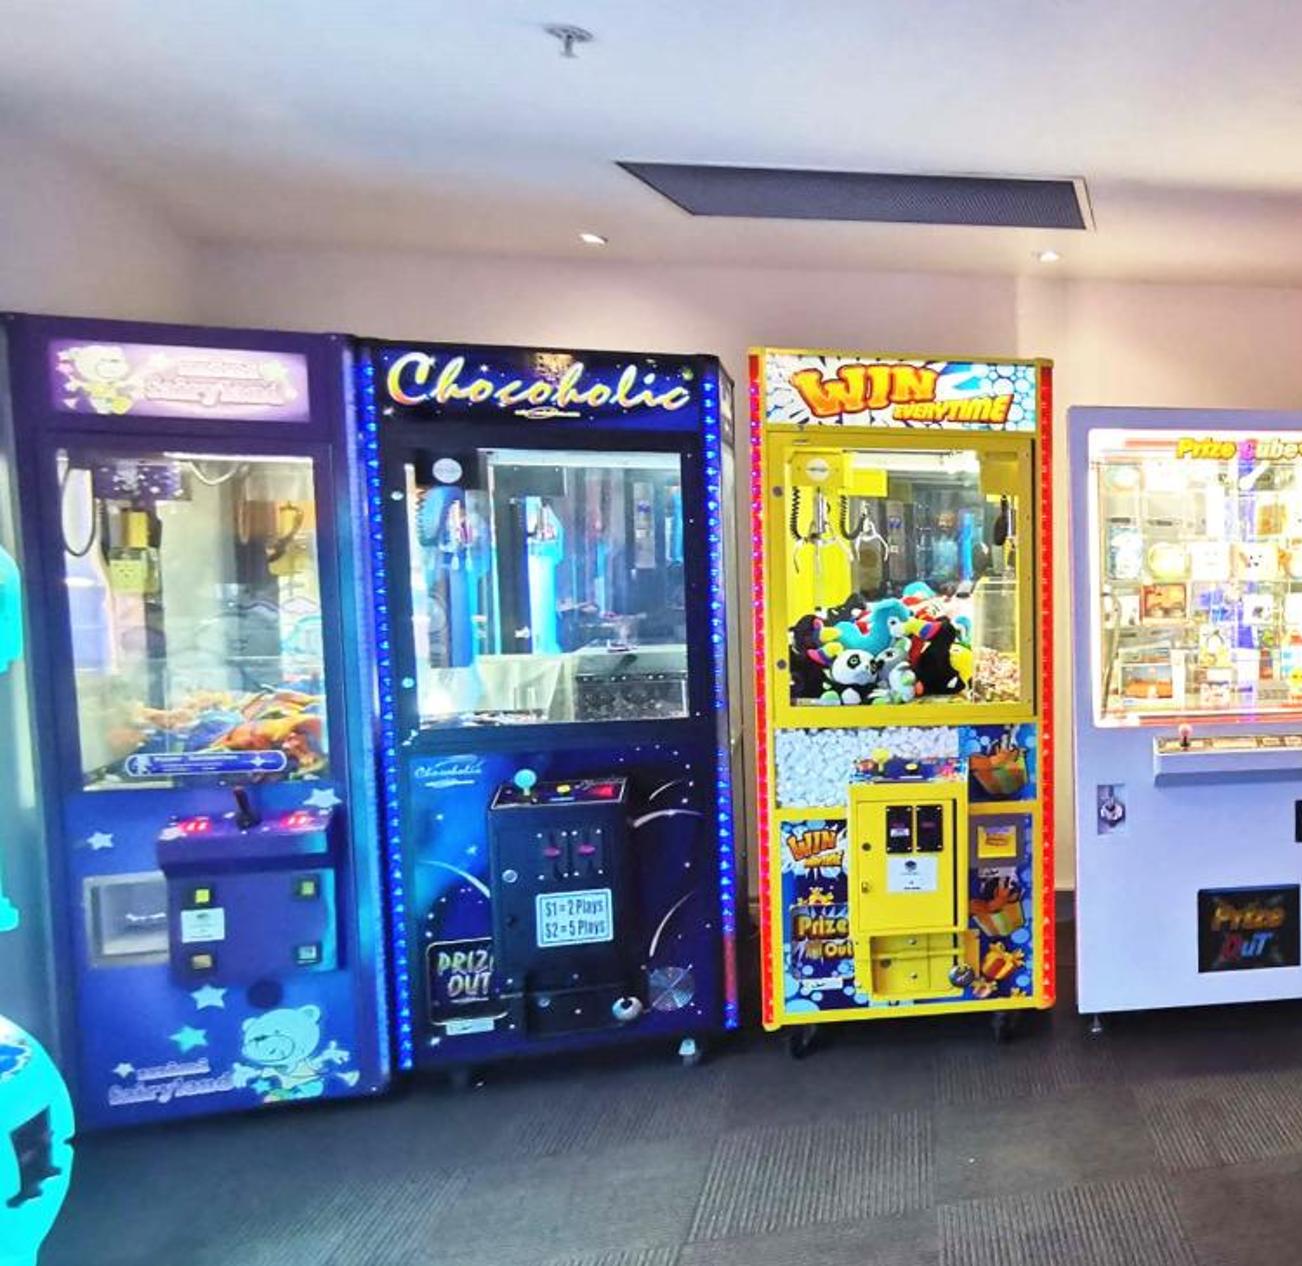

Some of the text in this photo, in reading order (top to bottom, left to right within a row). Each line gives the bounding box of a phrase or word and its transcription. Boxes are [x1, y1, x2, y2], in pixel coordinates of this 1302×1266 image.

[387, 352, 691, 411] Chocoholic
[789, 363, 940, 418] WIN
[892, 394, 1014, 423] EVERYTIME
[1176, 437, 1236, 460] Prize
[787, 830, 837, 861] WIN
[576, 899, 604, 914] Plays
[578, 920, 605, 935] Plays
[797, 917, 849, 937] Prize
[437, 949, 494, 977] PRIZ
[447, 971, 491, 997] OUT
